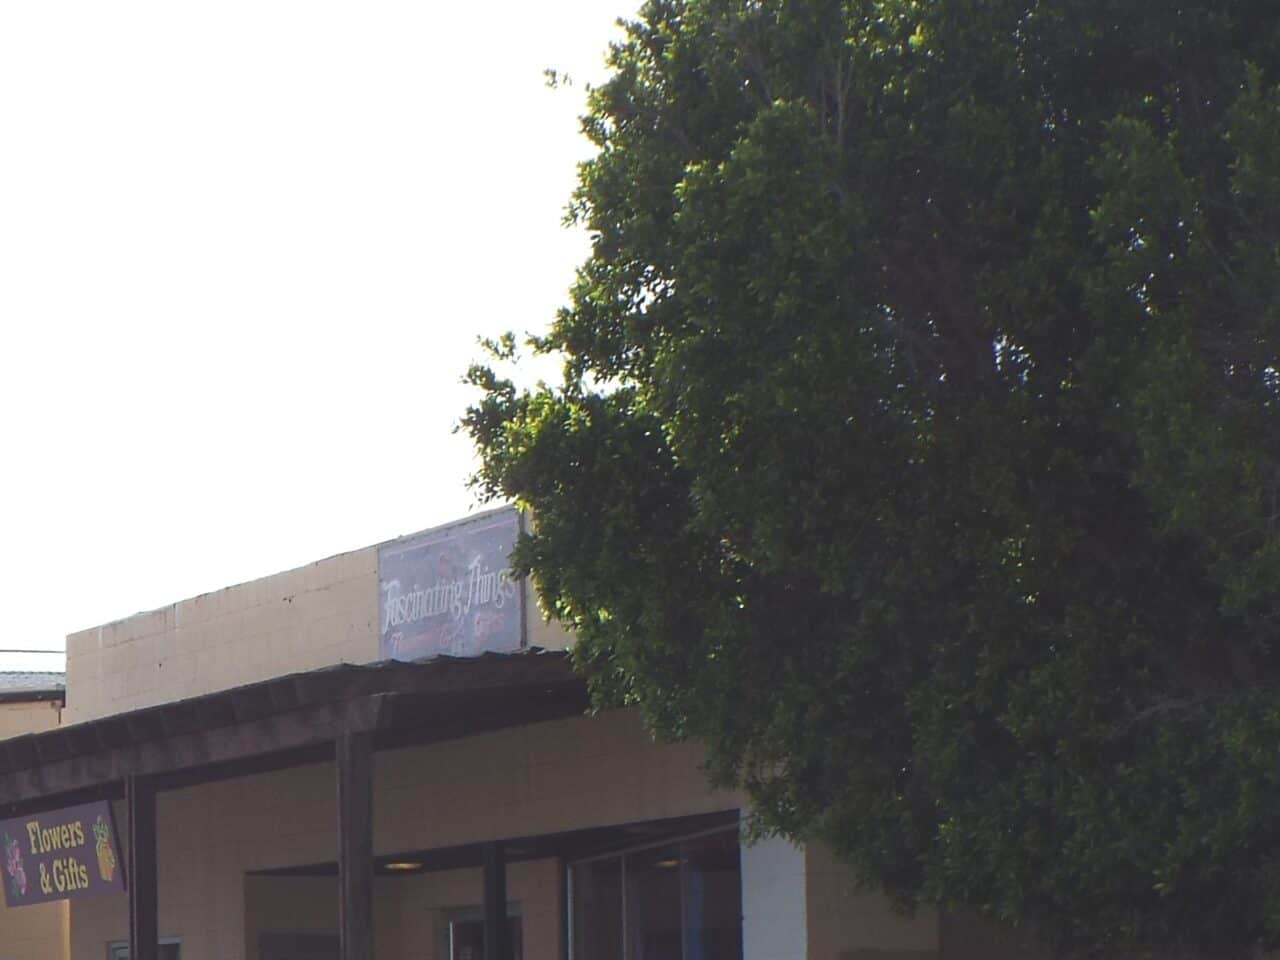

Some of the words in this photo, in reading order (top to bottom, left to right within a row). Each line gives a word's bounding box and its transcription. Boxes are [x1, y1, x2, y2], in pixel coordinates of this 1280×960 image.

[26, 821, 85, 854] Flowers
[39, 863, 52, 895] &
[53, 857, 89, 892] Gifts
